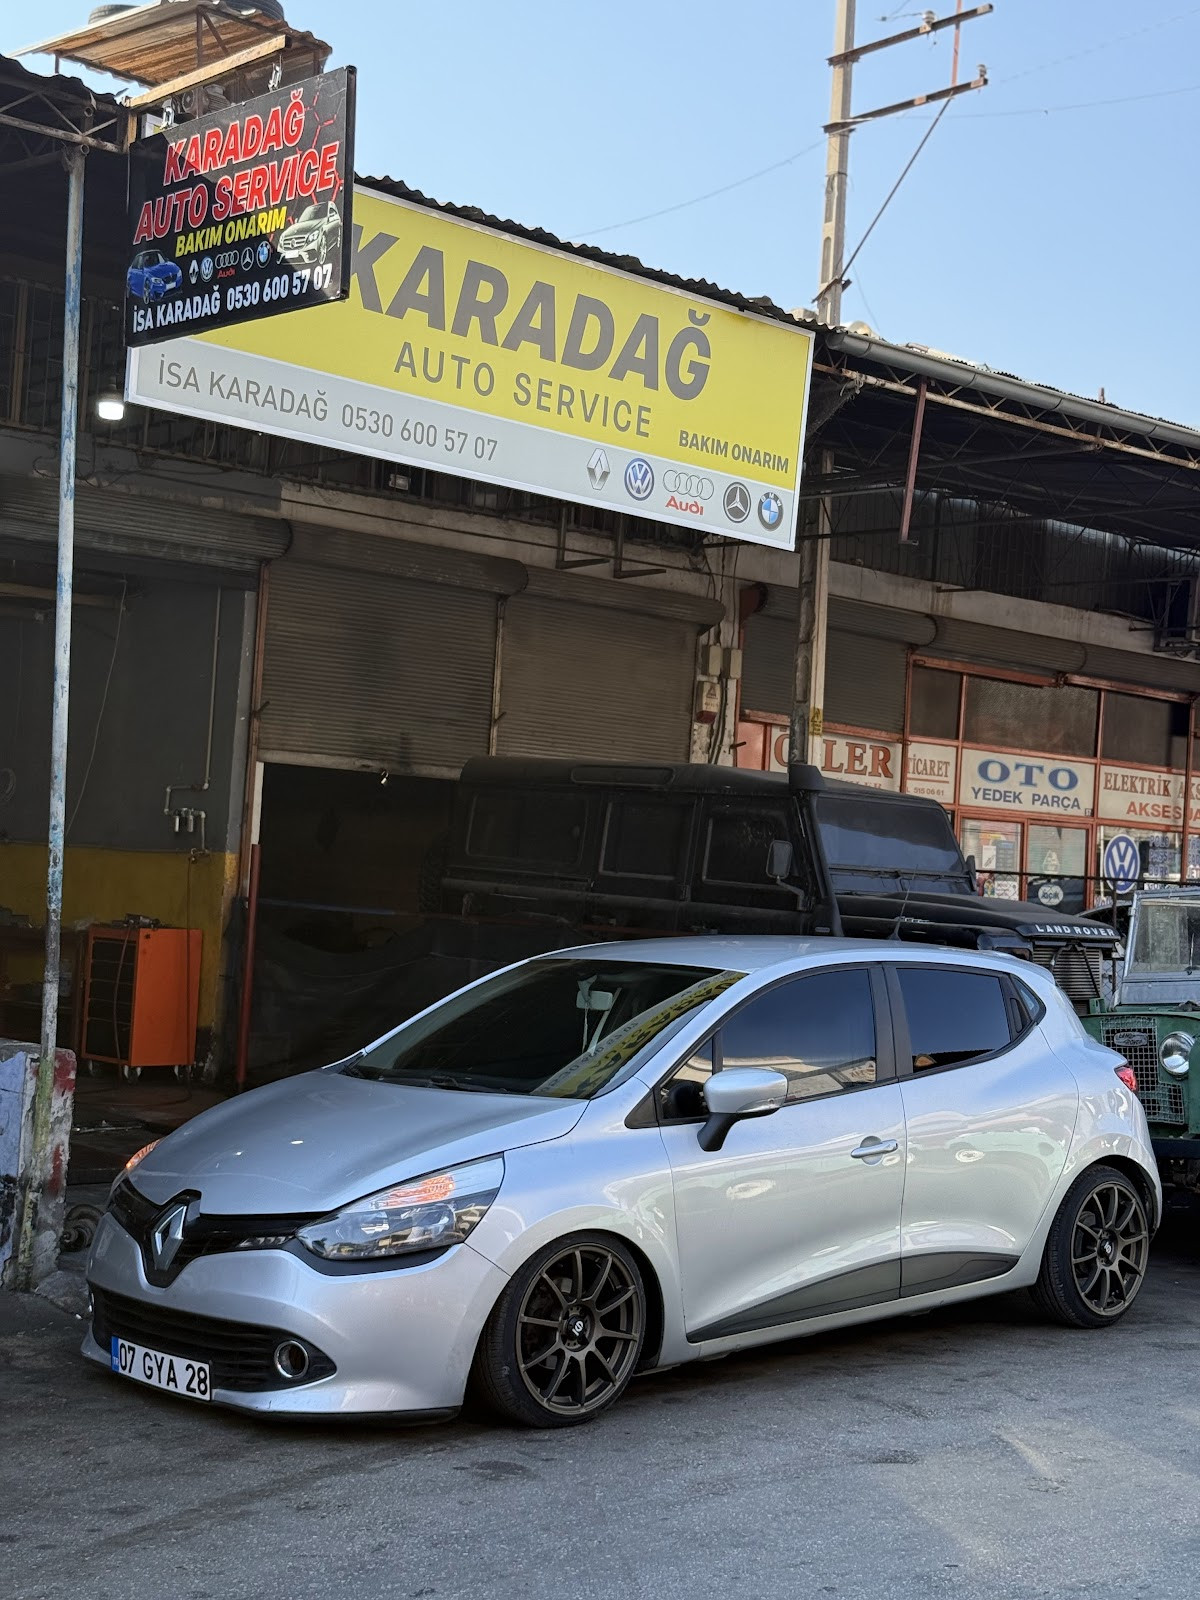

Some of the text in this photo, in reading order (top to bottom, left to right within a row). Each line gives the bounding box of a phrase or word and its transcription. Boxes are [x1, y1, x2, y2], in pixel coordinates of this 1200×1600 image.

[163, 88, 305, 186] KARADAĞ
[133, 140, 340, 246] AUTO SERVICE
[175, 205, 287, 258] BAKIM ONARIM
[133, 263, 333, 333] İSA KARADAĞ 0530 600 57 07
[217, 268, 236, 279] Audi
[351, 222, 712, 401] KARADAĞ
[158, 353, 498, 461] İSA KARADAĞ 0530 600 57 07
[393, 341, 652, 438] AUTO SERVICE
[679, 430, 790, 475] BAKIM ONARIM
[665, 495, 704, 516] Audi
[971, 787, 1081, 812] YEDEK PARÇA
[977, 758, 1079, 792] OTO
[1103, 772, 1172, 798] ELEKTRİK
[1035, 924, 1115, 938] LAND ROVER
[119, 1342, 208, 1396] 07 GYA 28
